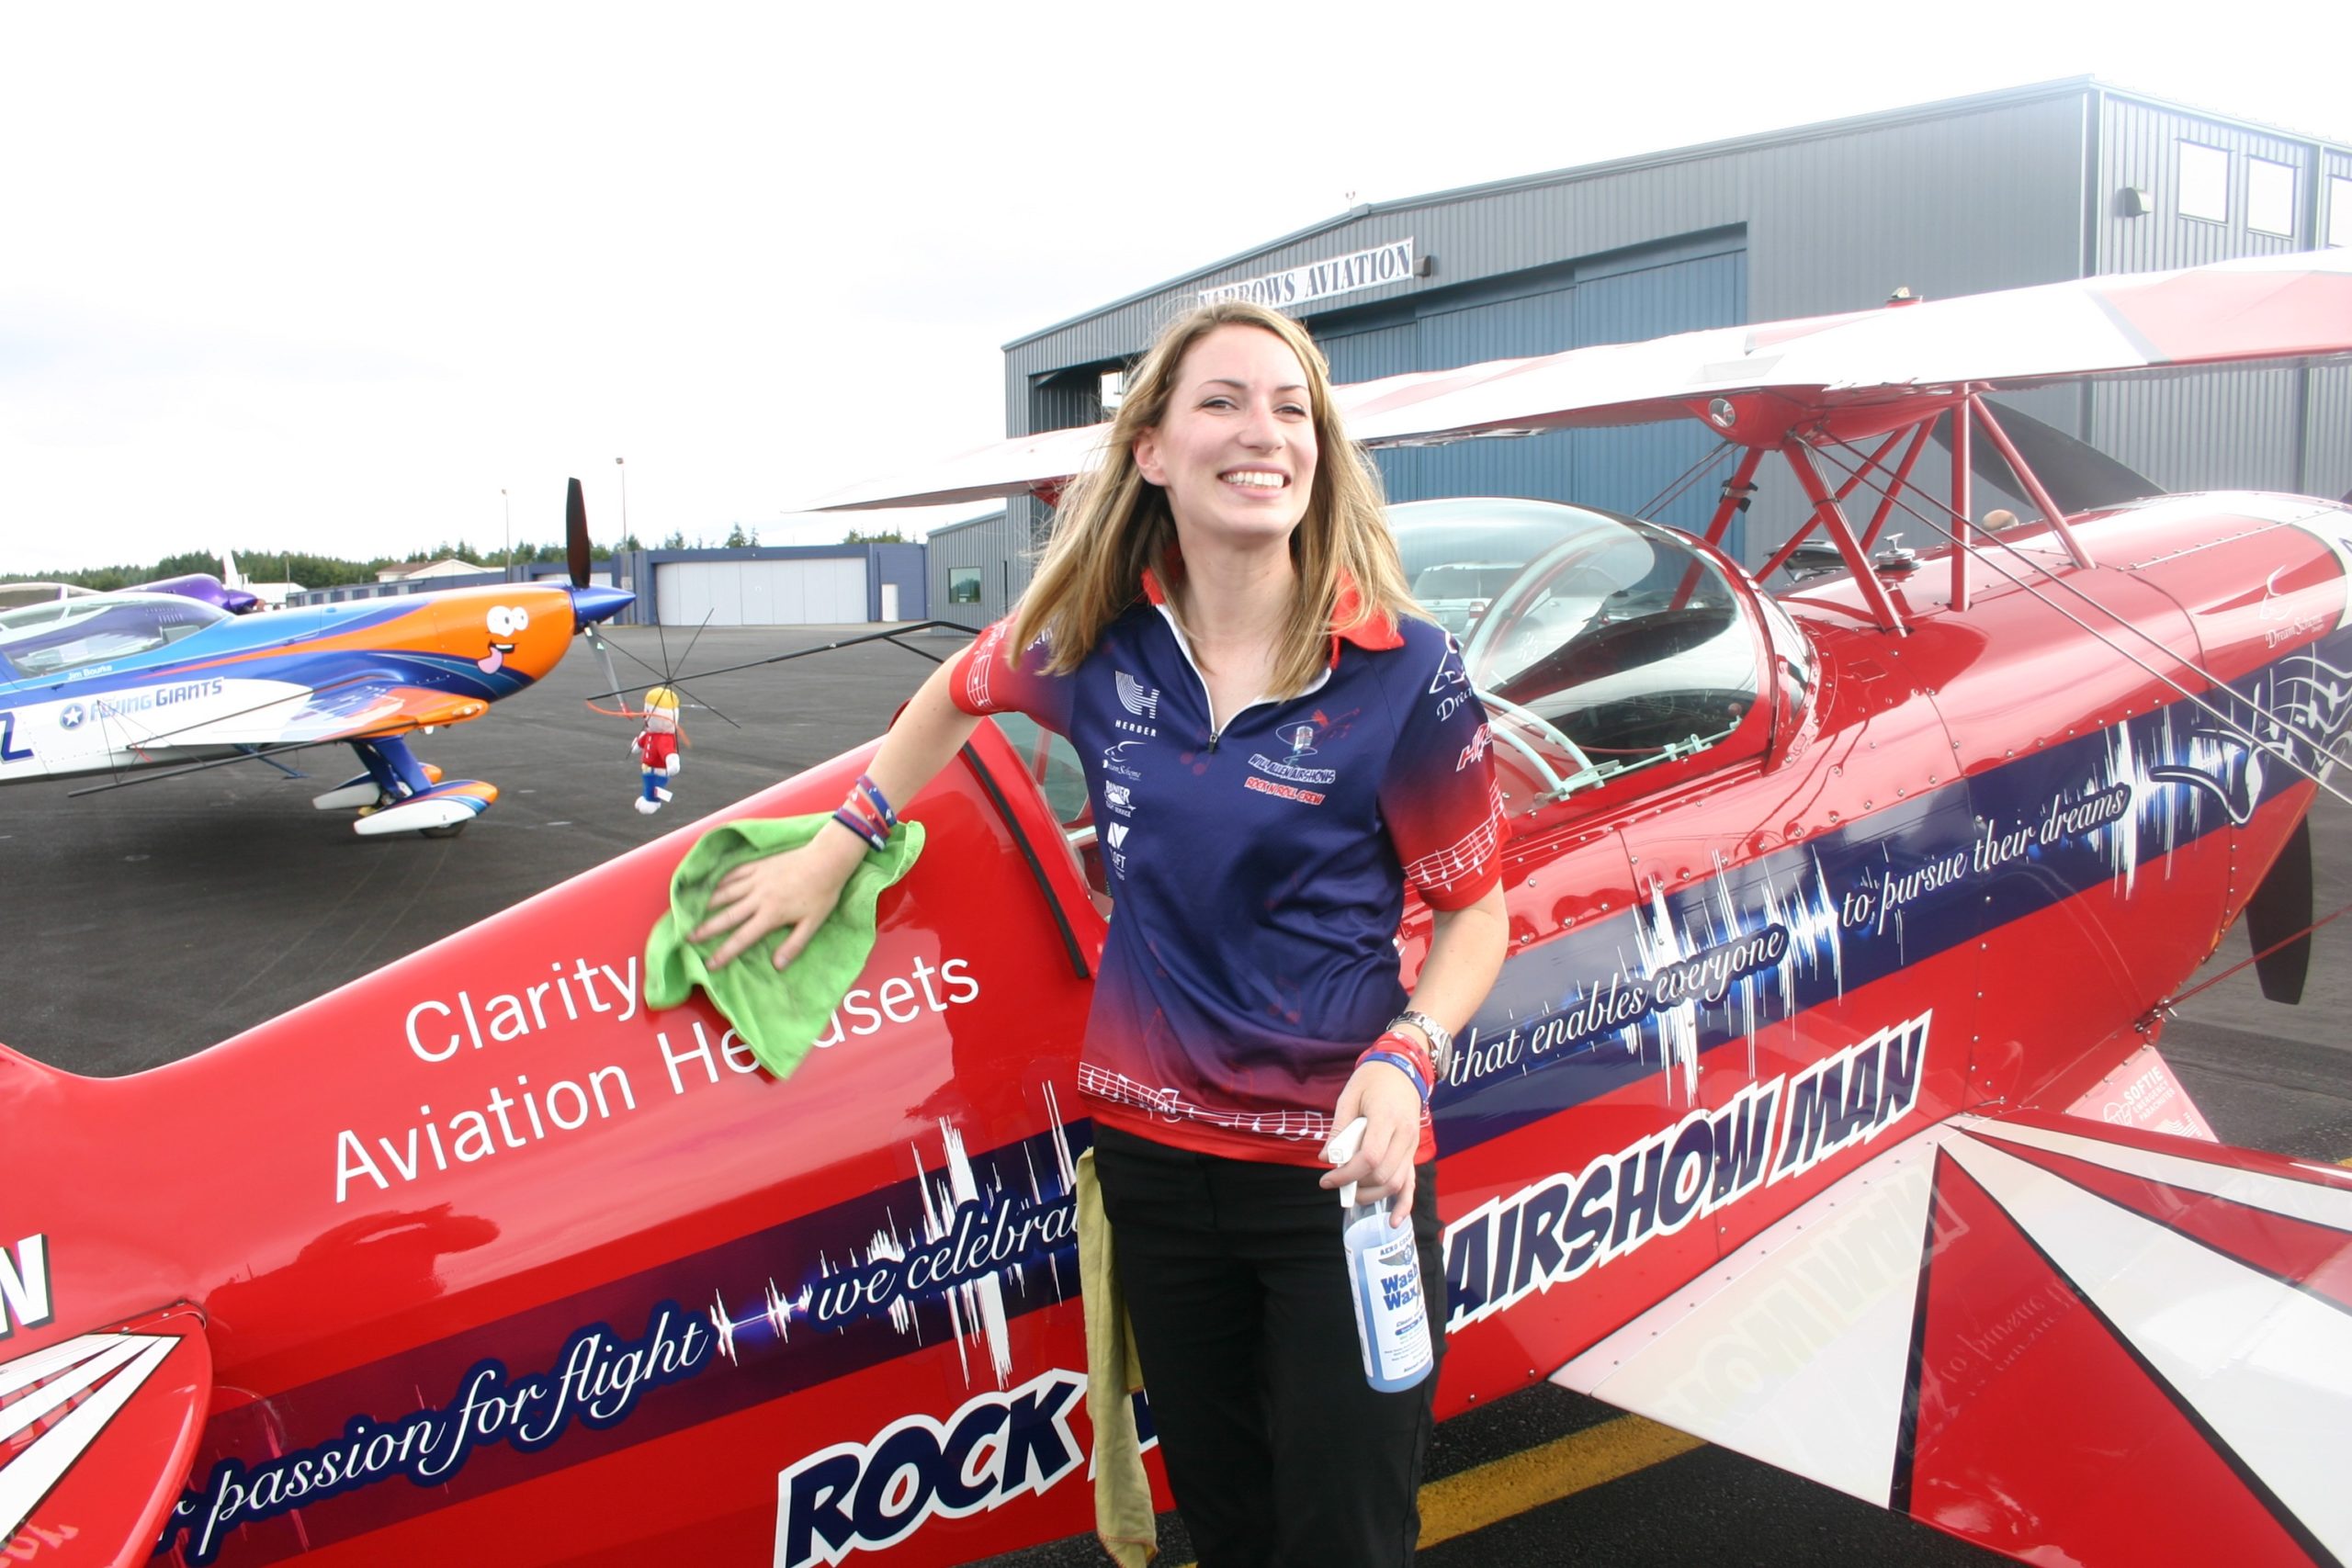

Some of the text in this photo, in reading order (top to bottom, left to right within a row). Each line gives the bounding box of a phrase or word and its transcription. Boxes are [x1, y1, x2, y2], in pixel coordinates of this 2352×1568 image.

[1305, 243, 1411, 298] AVIATION
[1244, 776, 1270, 792] ROCK
[1274, 784, 1298, 799] ROLL
[1296, 790, 1326, 806] CREW
[1248, 753, 1336, 784] WILL ALLEN AIRSHOWS
[1450, 1027, 1524, 1086] that
[1532, 973, 1649, 1054] enables
[1655, 931, 1784, 1003] everyone
[1840, 892, 1875, 927] to
[1878, 850, 1968, 935] pursue
[1973, 816, 2037, 873] their
[2041, 786, 2127, 846] dreams
[406, 955, 641, 1063] Clarity
[2123, 1066, 2164, 1106] SOFTIE
[334, 1062, 637, 1203] Aviation
[1445, 1009, 1932, 1334] AIRSHOW MAN
[1380, 1262, 1419, 1294] Wash
[1383, 1285, 1418, 1311] Wax
[198, 1419, 447, 1556] passion
[419, 1370, 547, 1475] for
[520, 1311, 708, 1441] flight
[819, 1268, 898, 1321] we
[774, 1367, 1088, 1568] ROCK
